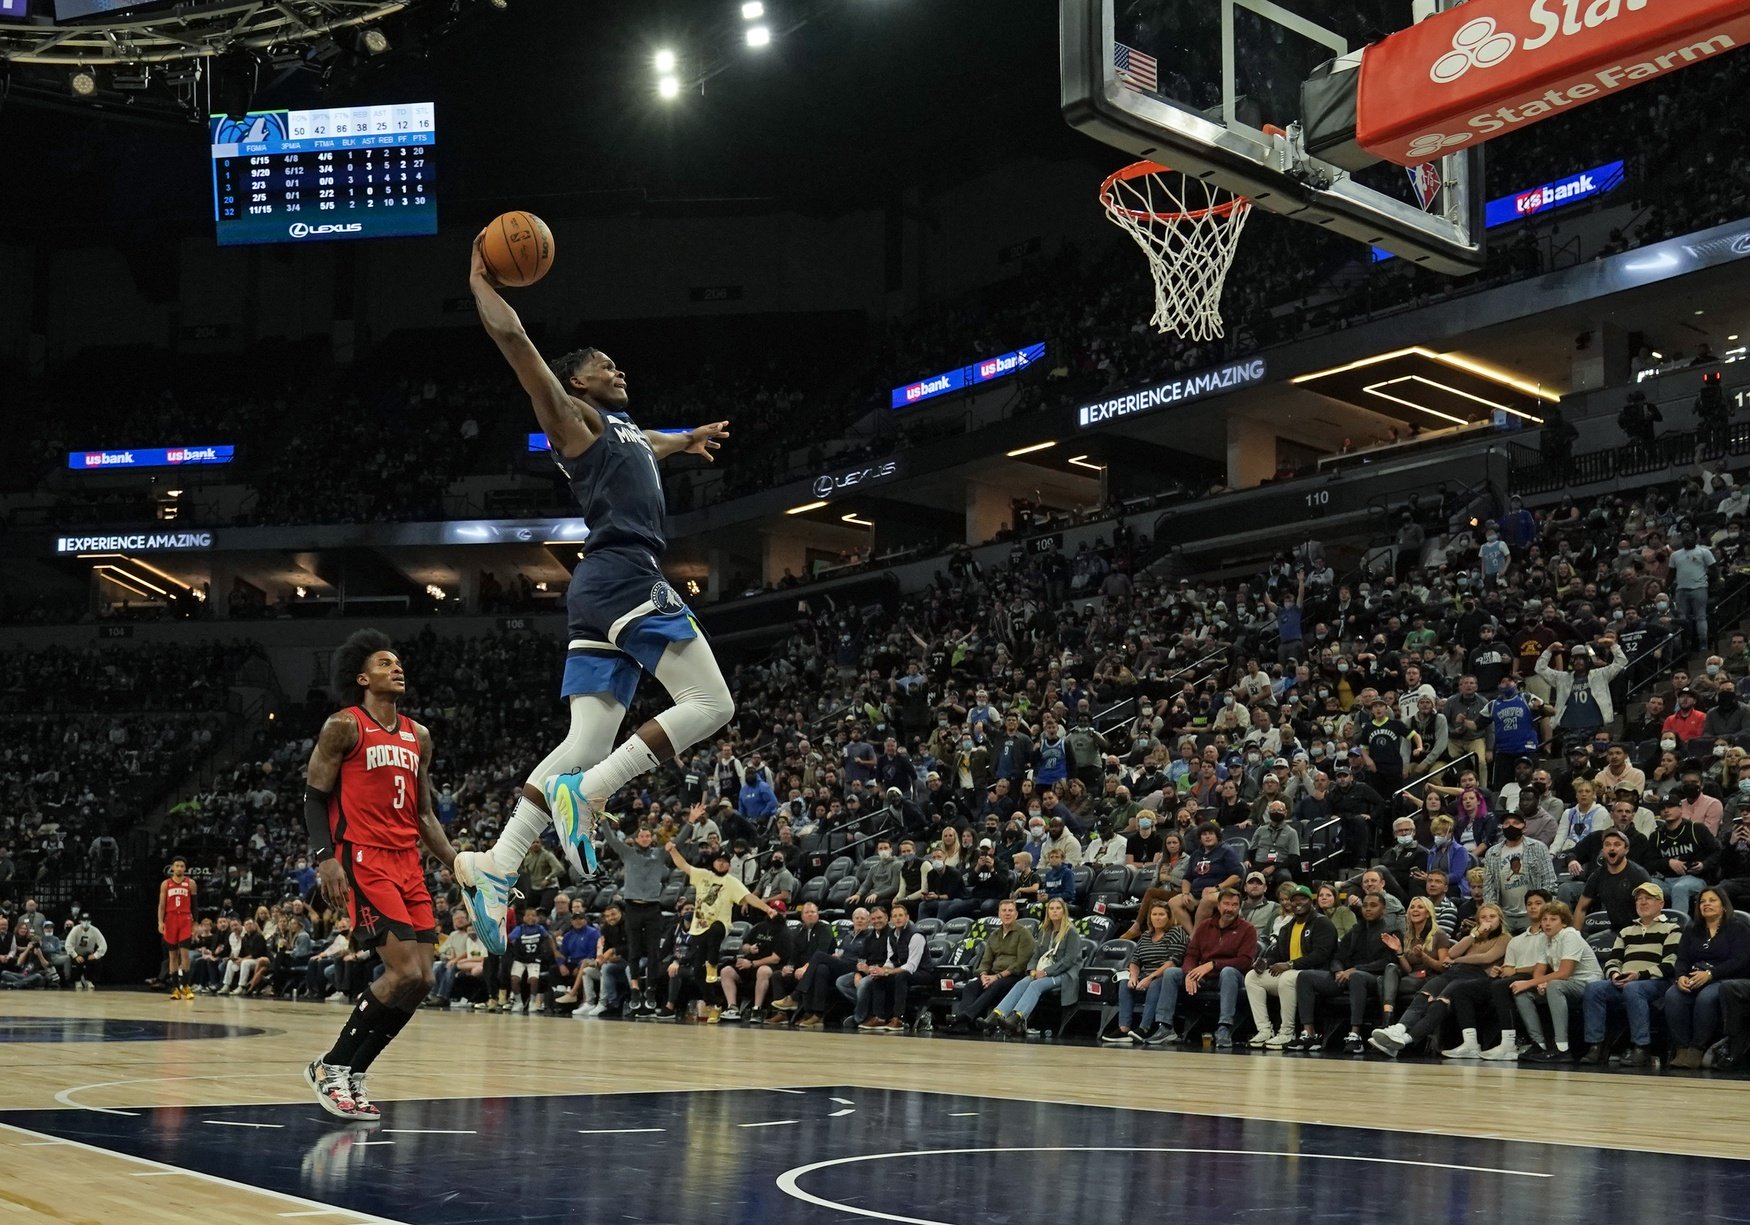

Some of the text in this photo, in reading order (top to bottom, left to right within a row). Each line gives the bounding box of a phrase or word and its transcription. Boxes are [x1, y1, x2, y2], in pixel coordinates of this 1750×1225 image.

[1467, 33, 1736, 134] State Farm
[294, 120, 429, 136] 50 42 86 38 25 12 16
[397, 135, 407, 143] PF
[250, 156, 270, 165] 6/15
[284, 154, 299, 163] 4/8
[318, 152, 333, 161] 4/6
[348, 151, 353, 159] 1
[366, 150, 372, 158] 7
[383, 149, 390, 157] 2
[400, 148, 406, 156] 3
[413, 147, 424, 155] 20
[251, 168, 270, 177] 9/20
[284, 167, 304, 175] 6/12
[318, 164, 333, 173] 3/4
[347, 163, 353, 171] 0
[366, 162, 372, 171] 3
[384, 161, 390, 169] 5
[400, 160, 406, 168] 2
[413, 159, 424, 168] 27
[251, 181, 266, 190] 2/3
[285, 179, 299, 187] 0/1
[318, 177, 334, 186] 0/0
[348, 176, 354, 184] 3
[367, 174, 373, 183] 1
[400, 173, 407, 181] 3
[415, 172, 422, 180] 4
[224, 184, 423, 204] 20 2/5 0/1 2/2 1 0 5 1 6
[224, 196, 426, 216] 32 11/15 3/4 5/5 2 2 10 3 30
[309, 223, 362, 234] LEXUS
[981, 351, 1029, 377] usbank
[906, 376, 951, 400] usbank
[1090, 360, 1265, 423] EXPERIENCE AMAZING
[85, 448, 216, 465] usbank usbank
[835, 461, 896, 488] LEXUS
[1306, 490, 1329, 507] 110
[66, 533, 211, 551] EXPERIENCE AMAZING
[506, 619, 525, 629] 106
[1625, 642, 1638, 653] 32
[1574, 690, 1588, 704] 10
[1503, 717, 1518, 731] 21
[366, 744, 420, 779] ROCKETS
[394, 775, 406, 809] 3
